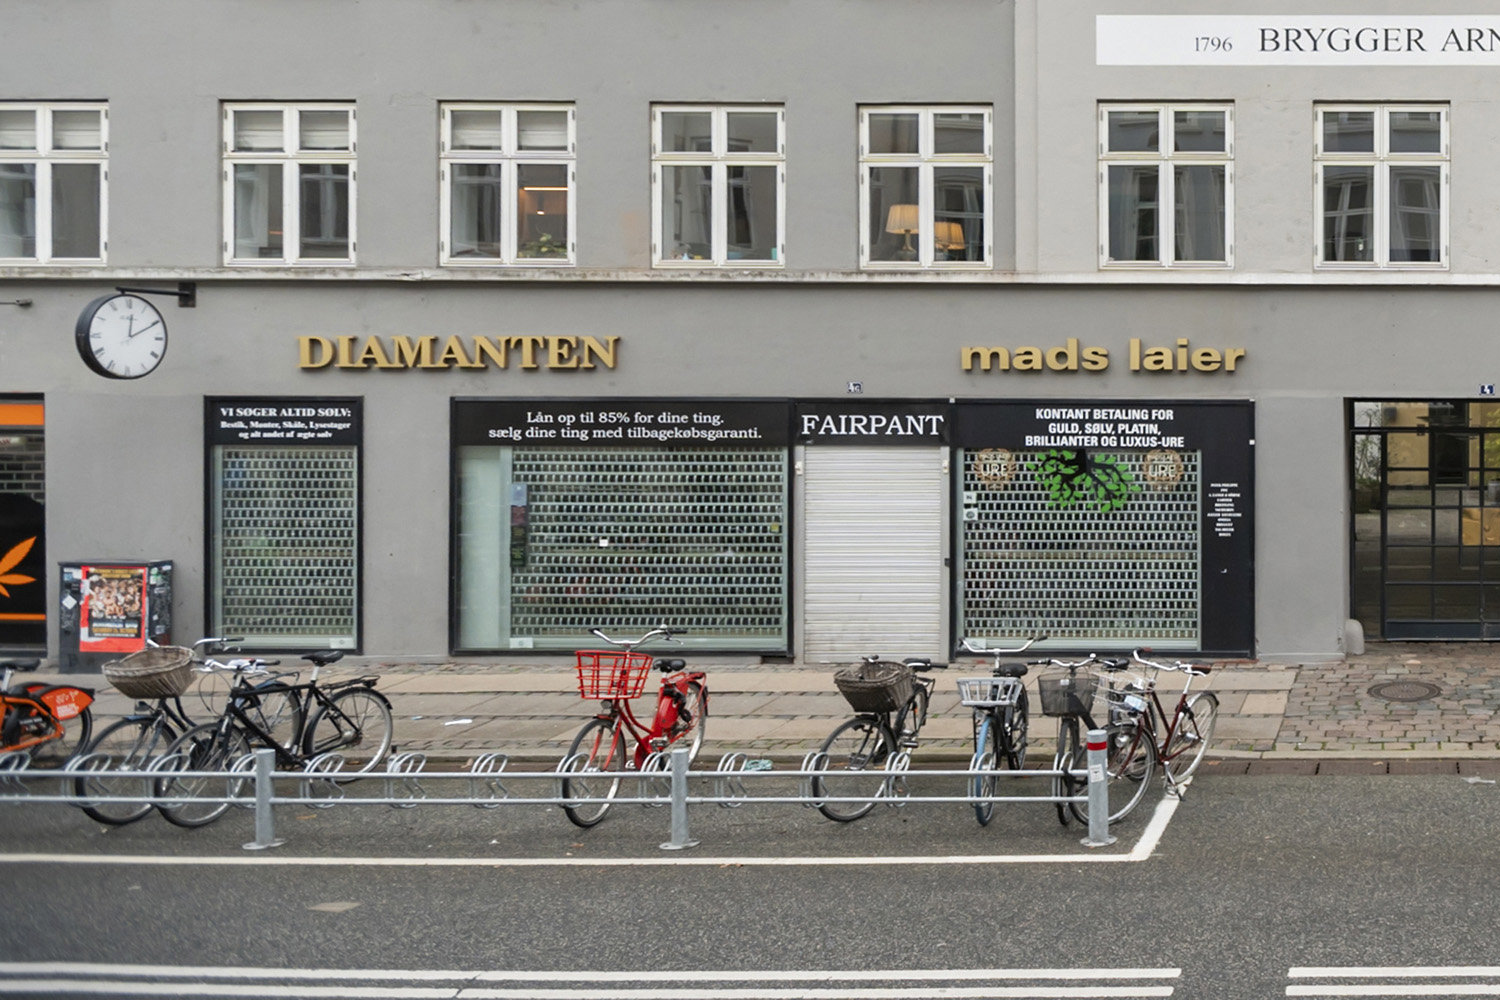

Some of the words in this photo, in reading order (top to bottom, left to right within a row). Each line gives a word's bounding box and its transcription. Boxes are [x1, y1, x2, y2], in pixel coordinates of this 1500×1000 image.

[1195, 37, 1233, 52] 1796
[1258, 28, 1427, 52] BRYGGER
[297, 335, 620, 369] DIAMANTEN
[961, 338, 1109, 371] mads
[1129, 338, 1246, 371] laier
[220, 408, 234, 417] VI
[279, 408, 316, 417] ALTID
[527, 411, 553, 424] Lån
[558, 414, 576, 426] op
[579, 411, 594, 424] til
[599, 412, 630, 424] 85%
[634, 411, 654, 424] for
[657, 411, 689, 424] dine
[693, 411, 725, 426] ting.
[1035, 408, 1091, 420] KONTANT
[1093, 409, 1149, 420] BETALING
[1152, 409, 1174, 420] FOR
[801, 415, 945, 435] FAIRPANT
[1048, 423, 1083, 435] GULD,
[1085, 423, 1115, 435] SØLV,
[1117, 423, 1161, 436] PLATIN,
[488, 427, 522, 441] sælg
[525, 427, 557, 438] dine
[560, 427, 589, 441] ting
[592, 427, 623, 438] med
[627, 427, 762, 441] tilbagekøbsgaranti.
[1025, 436, 1098, 447] BRILLIANTER
[1100, 436, 1117, 447] OG
[1120, 436, 1184, 448] LUXUS-URE
